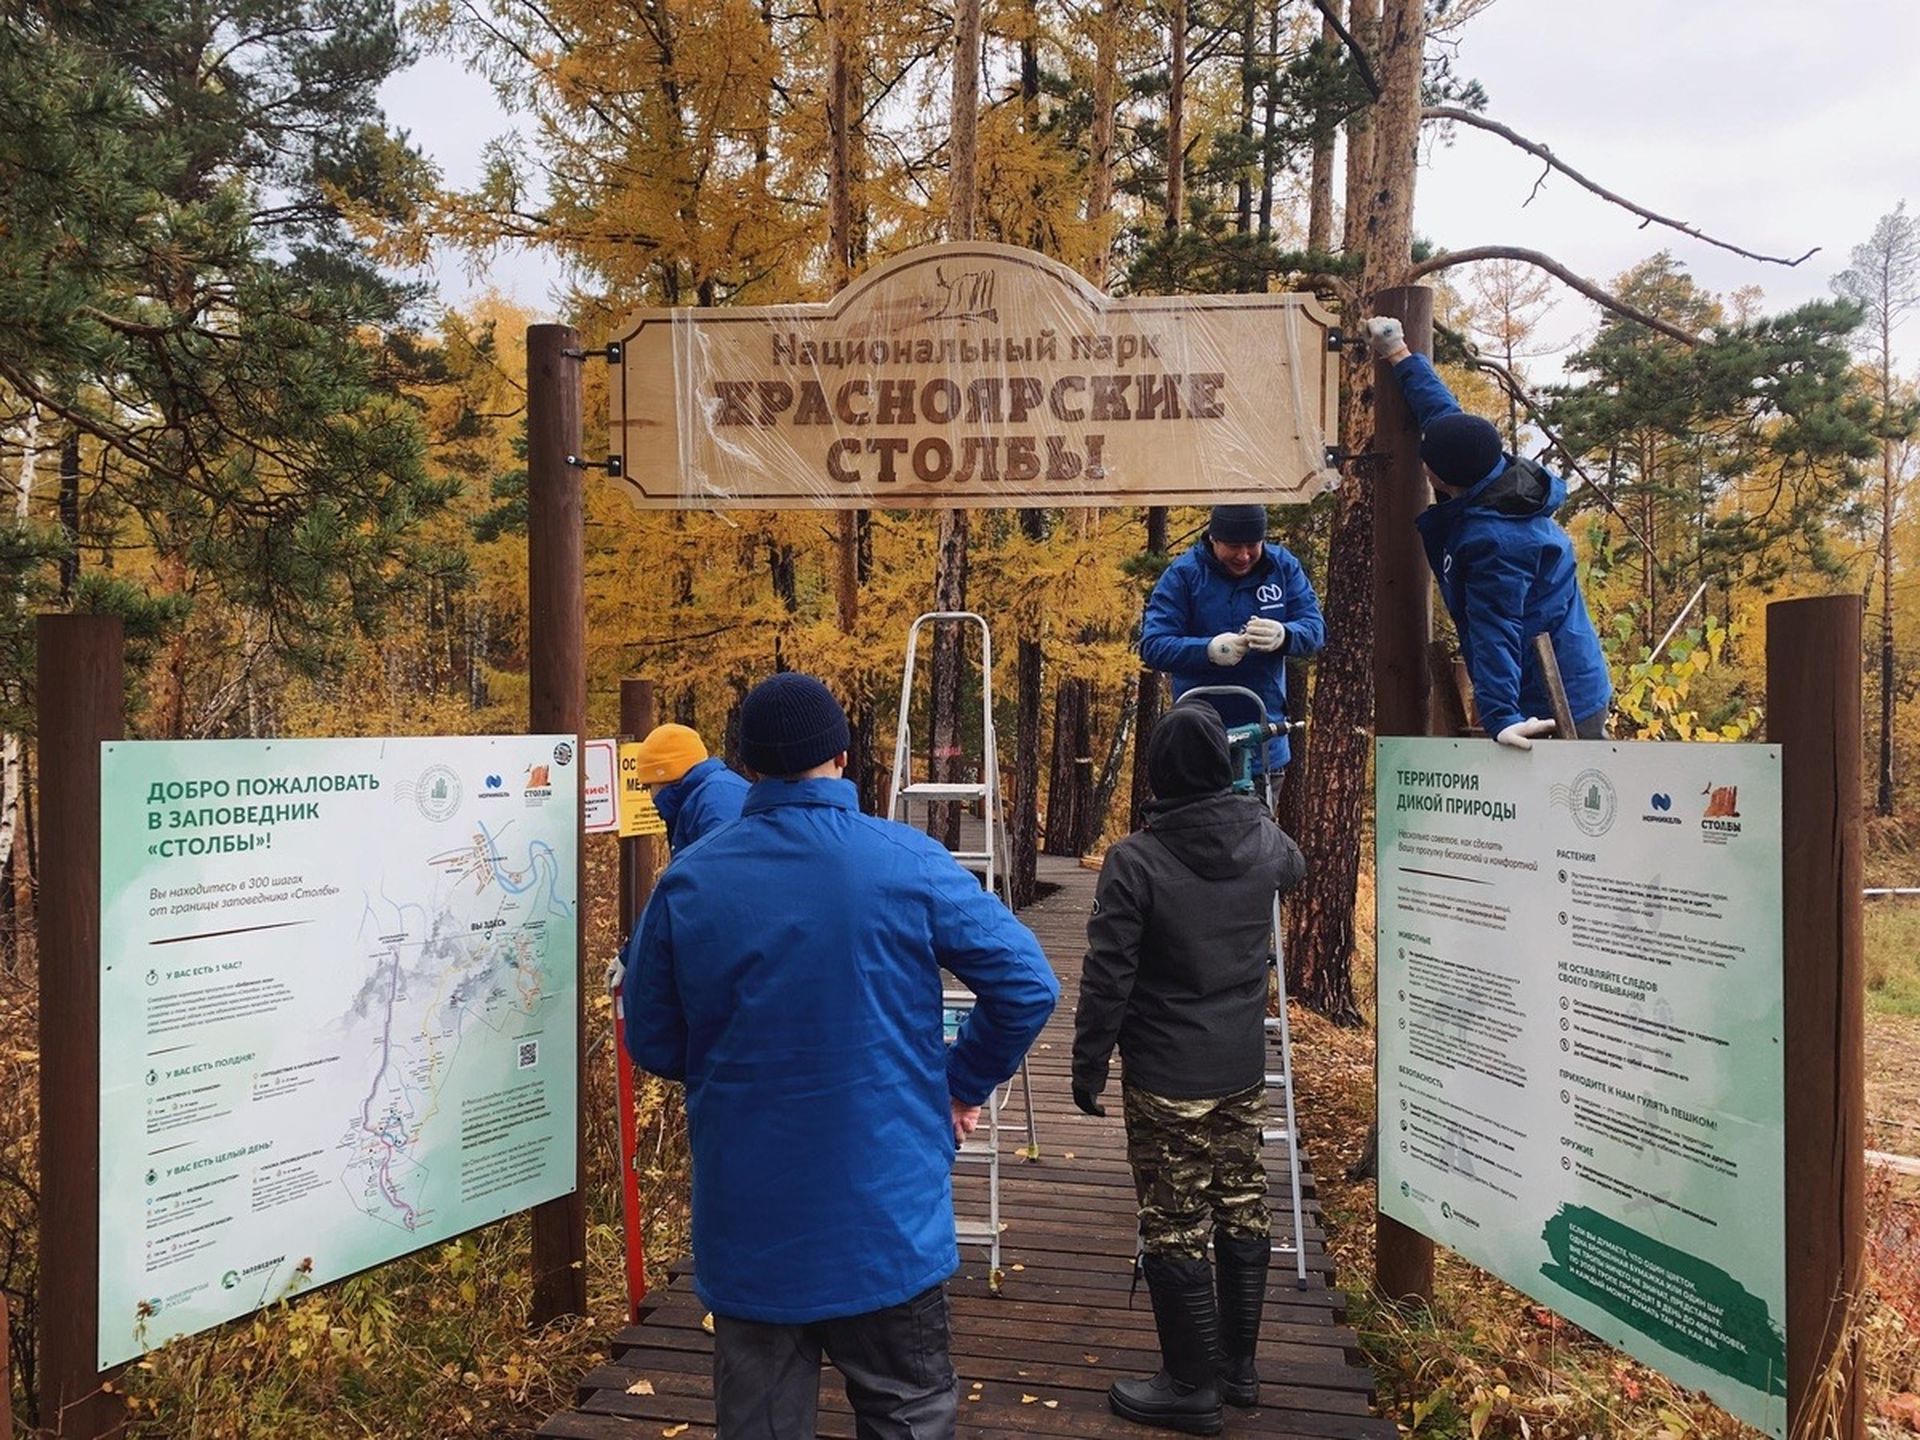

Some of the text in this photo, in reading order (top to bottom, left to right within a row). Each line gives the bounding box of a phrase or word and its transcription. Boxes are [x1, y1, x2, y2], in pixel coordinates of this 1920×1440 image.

[772, 327, 1161, 370] Национальный парк
[713, 372, 1225, 427] КРАСНОЯРСКИЕ
[827, 435, 1106, 484] СТОЛБЫ
[622, 758, 636, 771] ОС
[147, 774, 380, 804] ДОБРО ПОЖАЛОВАТЬ
[1397, 771, 1479, 790] ТЕРРИТОРИЯ
[148, 802, 320, 830] В ЗАПОВЕДНИК
[1397, 793, 1516, 821] ДИКОЙ ПРИРОДЫ
[1701, 820, 1742, 832] СТОЛБЫ
[148, 832, 271, 858] «СТОЛБЫ»!
[1398, 829, 1430, 841] Несколько
[1460, 838, 1472, 847] как
[1473, 838, 1503, 852] сделать
[1398, 841, 1414, 854] Вашу
[1416, 846, 1443, 858] прогулку
[1444, 848, 1482, 863] безопасной
[1489, 857, 1538, 871] комфортной
[1556, 849, 1596, 863] РАСТЕНИЯ
[149, 884, 340, 917] от границы заповедника «Столбы»
[150, 875, 304, 900] Вы находитесь в 300 шагах
[174, 969, 191, 979] ВАС
[193, 966, 214, 976] ЕСТЬ
[1558, 961, 1658, 993] НЕ ОСТАВЛЯЙТЕ СЛЕДОВ
[1558, 972, 1646, 1002] СВОЕГО ПРЕБЫВАНИЯ
[174, 1067, 191, 1077] ВАС
[192, 1062, 213, 1074] ЕСТЬ
[1398, 1065, 1444, 1089] БЕЗОПАСНОСТЬ
[1559, 1068, 1718, 1131] ПРИХОДИТЕ К НАМ ГУЛЯТЬ ПЕШКОМ!
[1560, 1136, 1594, 1158] ОРУЖИЕ
[174, 1164, 191, 1175] ВАС
[193, 1159, 214, 1170] ЕСТЬ
[215, 1148, 247, 1164] ЦЕЛЫЙ
[1628, 1252, 1643, 1264] ЧТО
[1629, 1263, 1665, 1287] БУМАЖКА
[1682, 1291, 1706, 1308] ОДИН
[1662, 1303, 1682, 1319] ДЕНЬ
